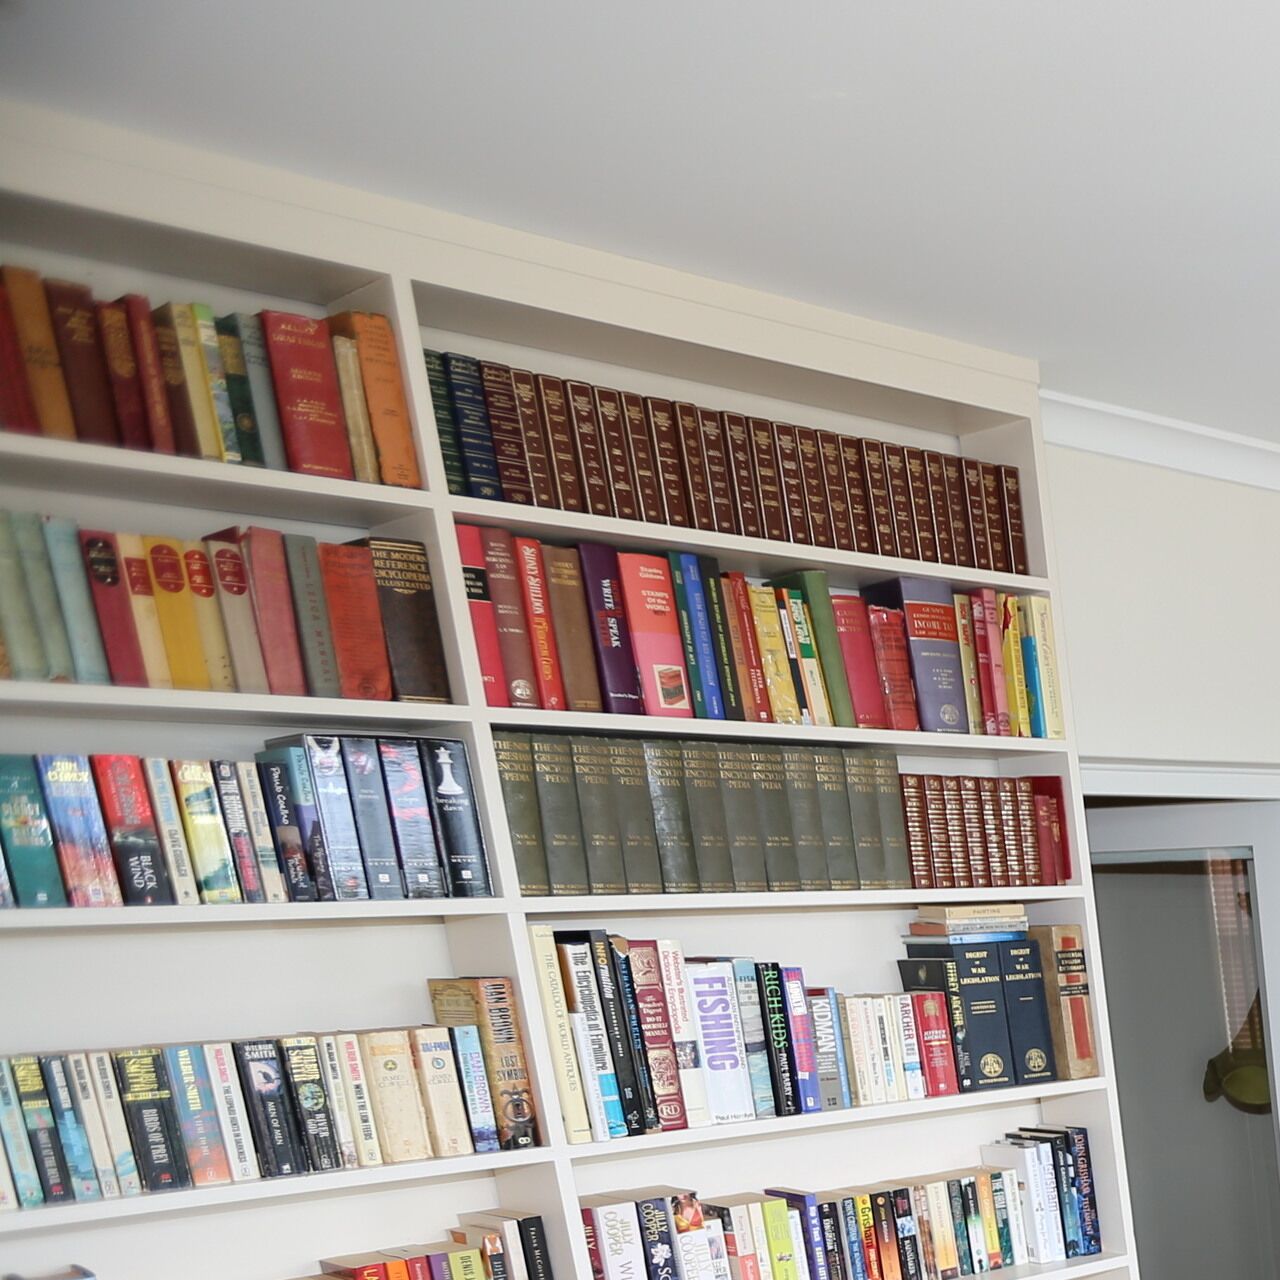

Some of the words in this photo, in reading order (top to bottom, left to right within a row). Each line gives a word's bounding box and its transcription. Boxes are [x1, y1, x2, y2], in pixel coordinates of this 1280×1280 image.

[374, 560, 427, 571] REFERENCE
[377, 580, 431, 590] ILLUSTRATED
[527, 576, 545, 614] SHELDON
[601, 579, 614, 610] WRITE
[641, 590, 668, 598] STAMPS
[607, 617, 622, 648] SPEAK
[535, 743, 550, 751] THE
[435, 797, 469, 805] breaking
[129, 857, 144, 888] WIND
[140, 856, 157, 889] BLACK
[544, 954, 553, 970] THE
[573, 951, 587, 965] The
[547, 971, 562, 1009] CATALOG
[764, 971, 782, 1009] RICH
[960, 976, 1000, 985] LEGISLATION
[1005, 973, 1041, 981] LEGISLATION
[485, 983, 506, 1005] DAN
[576, 970, 597, 1022] Encyclopedia
[662, 951, 673, 985] Dictionary
[669, 987, 680, 1033] Encyclopedia
[693, 976, 739, 1070] FISHING
[900, 1002, 914, 1041] ARCHER
[950, 994, 964, 1026] ARCHER
[490, 1007, 515, 1044] BROWN
[559, 1022, 570, 1049] WORLD
[589, 1023, 598, 1032] of
[771, 1014, 788, 1048] KIDS
[811, 999, 836, 1053] KIDMAN
[245, 1051, 275, 1059] SMITH
[470, 1053, 481, 1075] DAN
[590, 1034, 607, 1071] Furniture
[779, 1053, 789, 1071] PAUL
[177, 1050, 194, 1082] WILBUR
[564, 1052, 577, 1092] ANTIQUES
[475, 1076, 491, 1114] BROWN
[783, 1072, 793, 1097] BARRY
[142, 1109, 161, 1132] BIRDS
[267, 1101, 277, 1118] MEN
[274, 1129, 284, 1145] MEN
[306, 1119, 318, 1135] GOD
[315, 1113, 329, 1137] RIVER
[148, 1133, 163, 1142] OF
[1074, 1134, 1084, 1156] JOHN
[151, 1144, 169, 1163] PREY
[1060, 1167, 1068, 1192] GRISHAM
[1078, 1157, 1090, 1194] GRISHAM
[642, 1203, 659, 1242] COOPER
[655, 1209, 668, 1233] JILLY
[861, 1208, 875, 1249] Grisham
[1084, 1197, 1094, 1234] TESTAMENT
[529, 1227, 538, 1246] FRANK
[584, 1226, 597, 1250] JILLY
[604, 1212, 623, 1256] COOPER
[620, 1219, 634, 1245] JILLY
[459, 1256, 472, 1274] DENIS
[694, 1244, 712, 1272] JILLY
